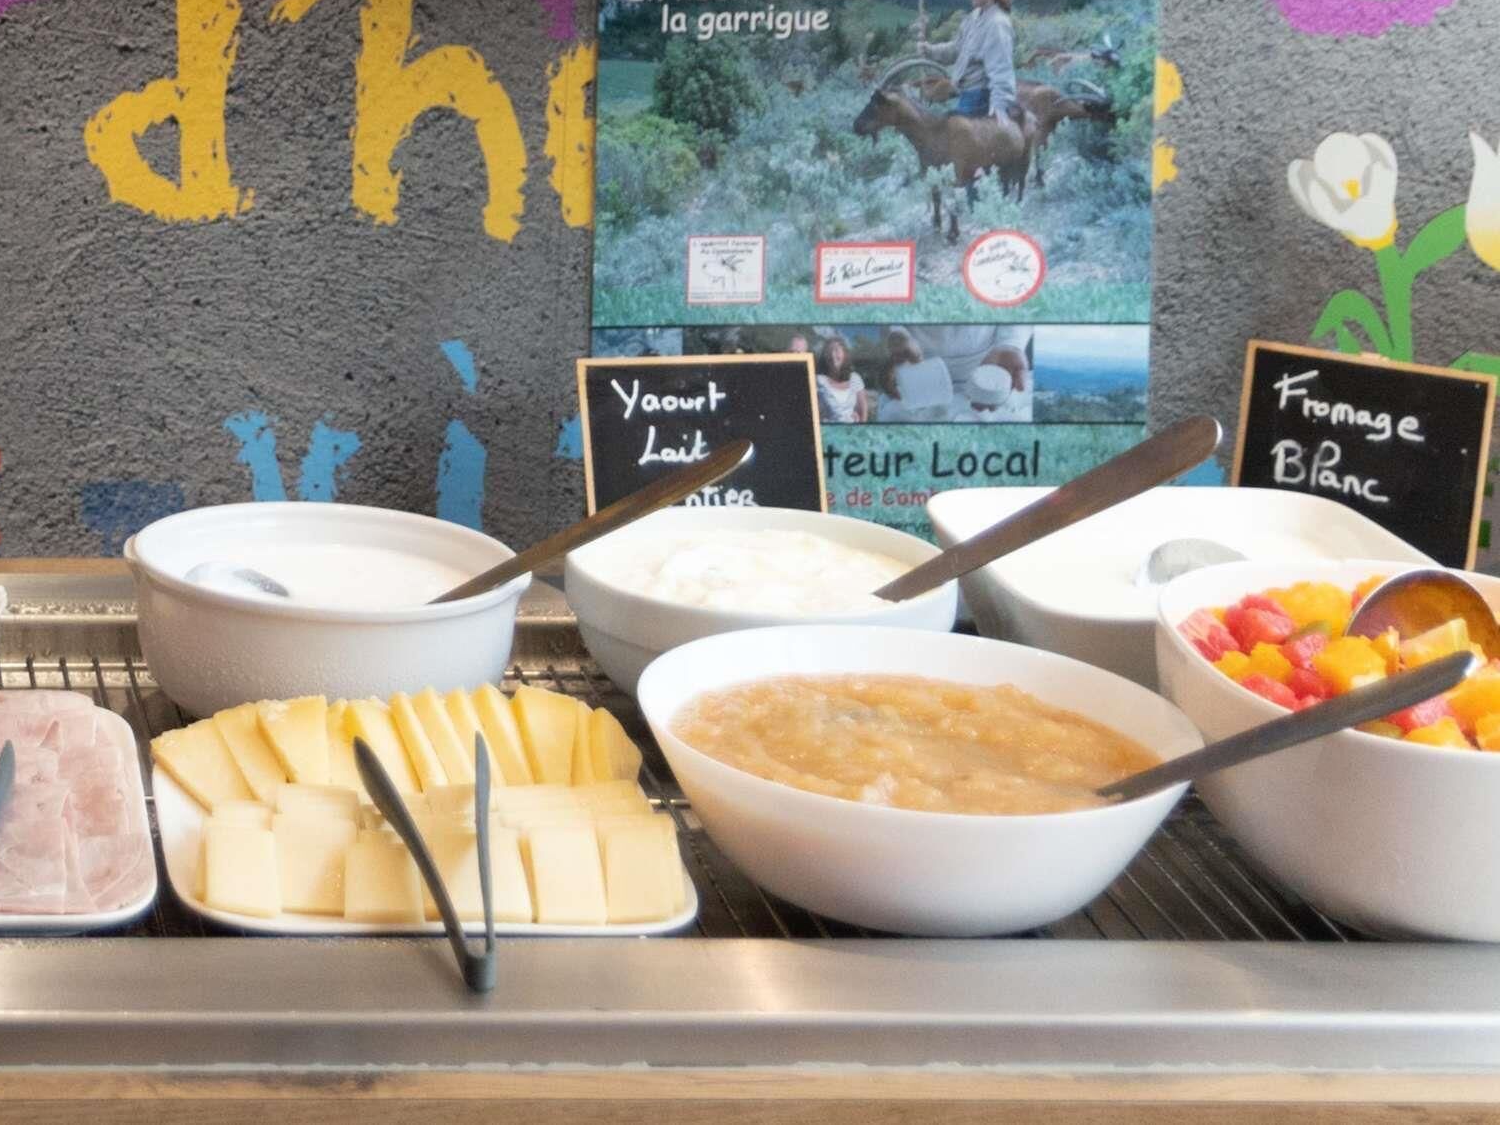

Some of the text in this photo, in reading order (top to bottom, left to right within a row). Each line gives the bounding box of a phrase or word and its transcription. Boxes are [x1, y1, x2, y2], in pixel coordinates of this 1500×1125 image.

[660, 3, 831, 41] la garrigue
[610, 378, 727, 420] Yaourt
[1272, 369, 1426, 441] Fromage
[638, 425, 711, 466] Lait
[932, 439, 1041, 479] Local
[1270, 438, 1390, 503] Blanc
[846, 486, 873, 507] de
